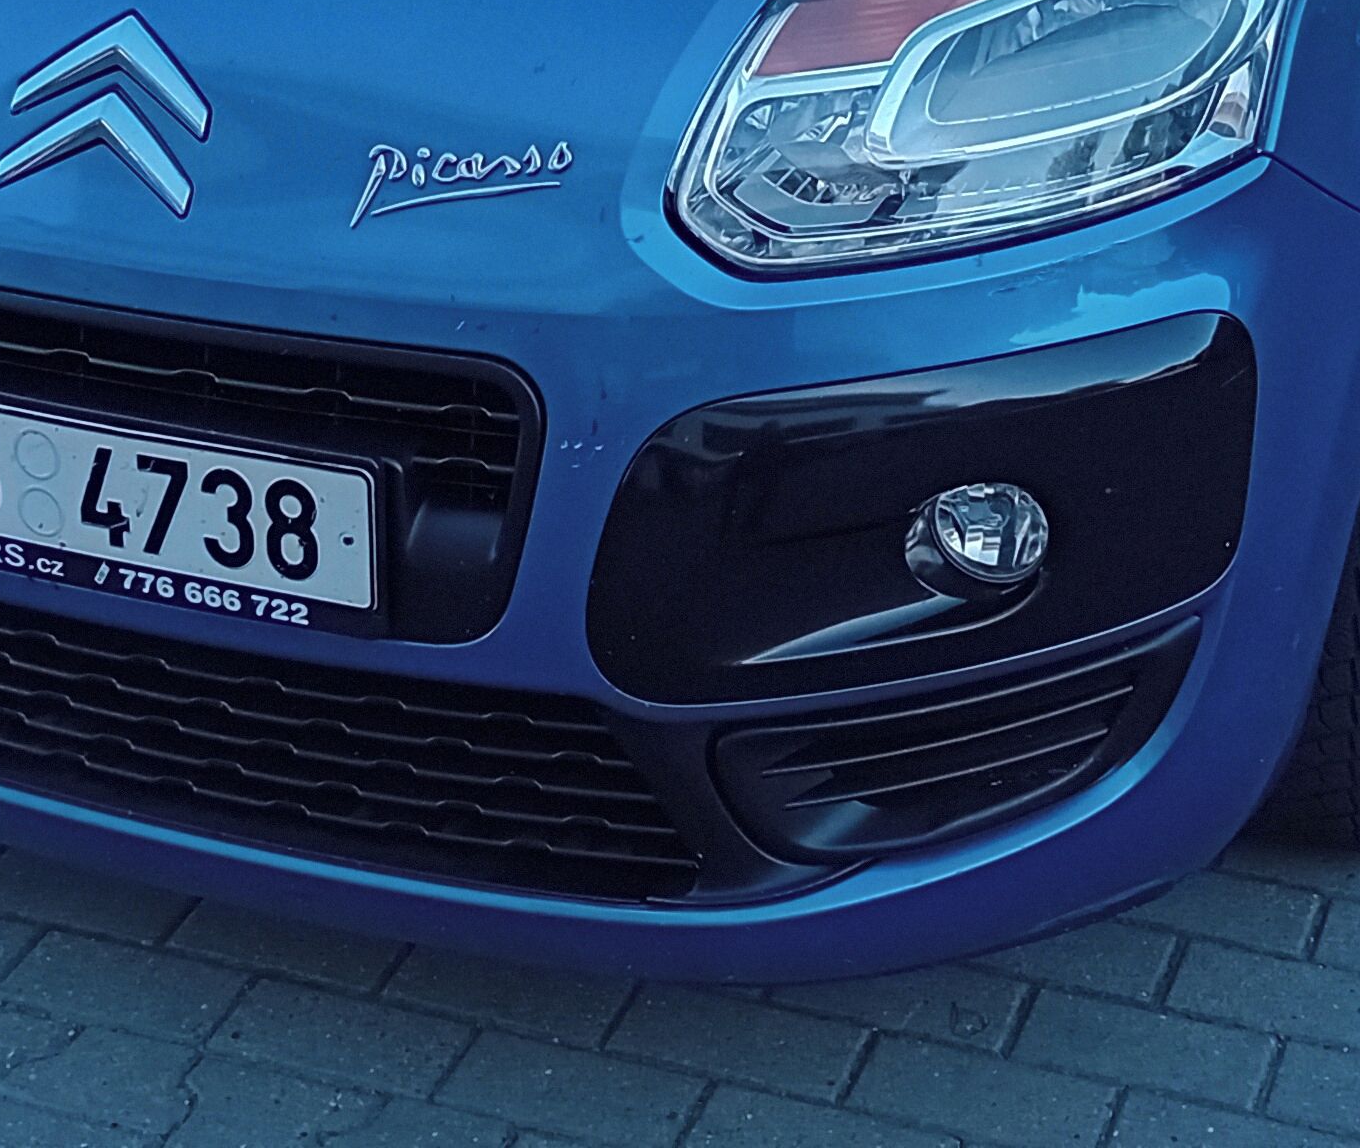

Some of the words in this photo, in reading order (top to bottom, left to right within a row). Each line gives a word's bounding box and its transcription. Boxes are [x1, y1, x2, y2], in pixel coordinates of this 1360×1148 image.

[80, 446, 321, 582] 4738
[118, 567, 176, 599] 776
[184, 581, 242, 613] 666
[250, 594, 310, 627] 722
